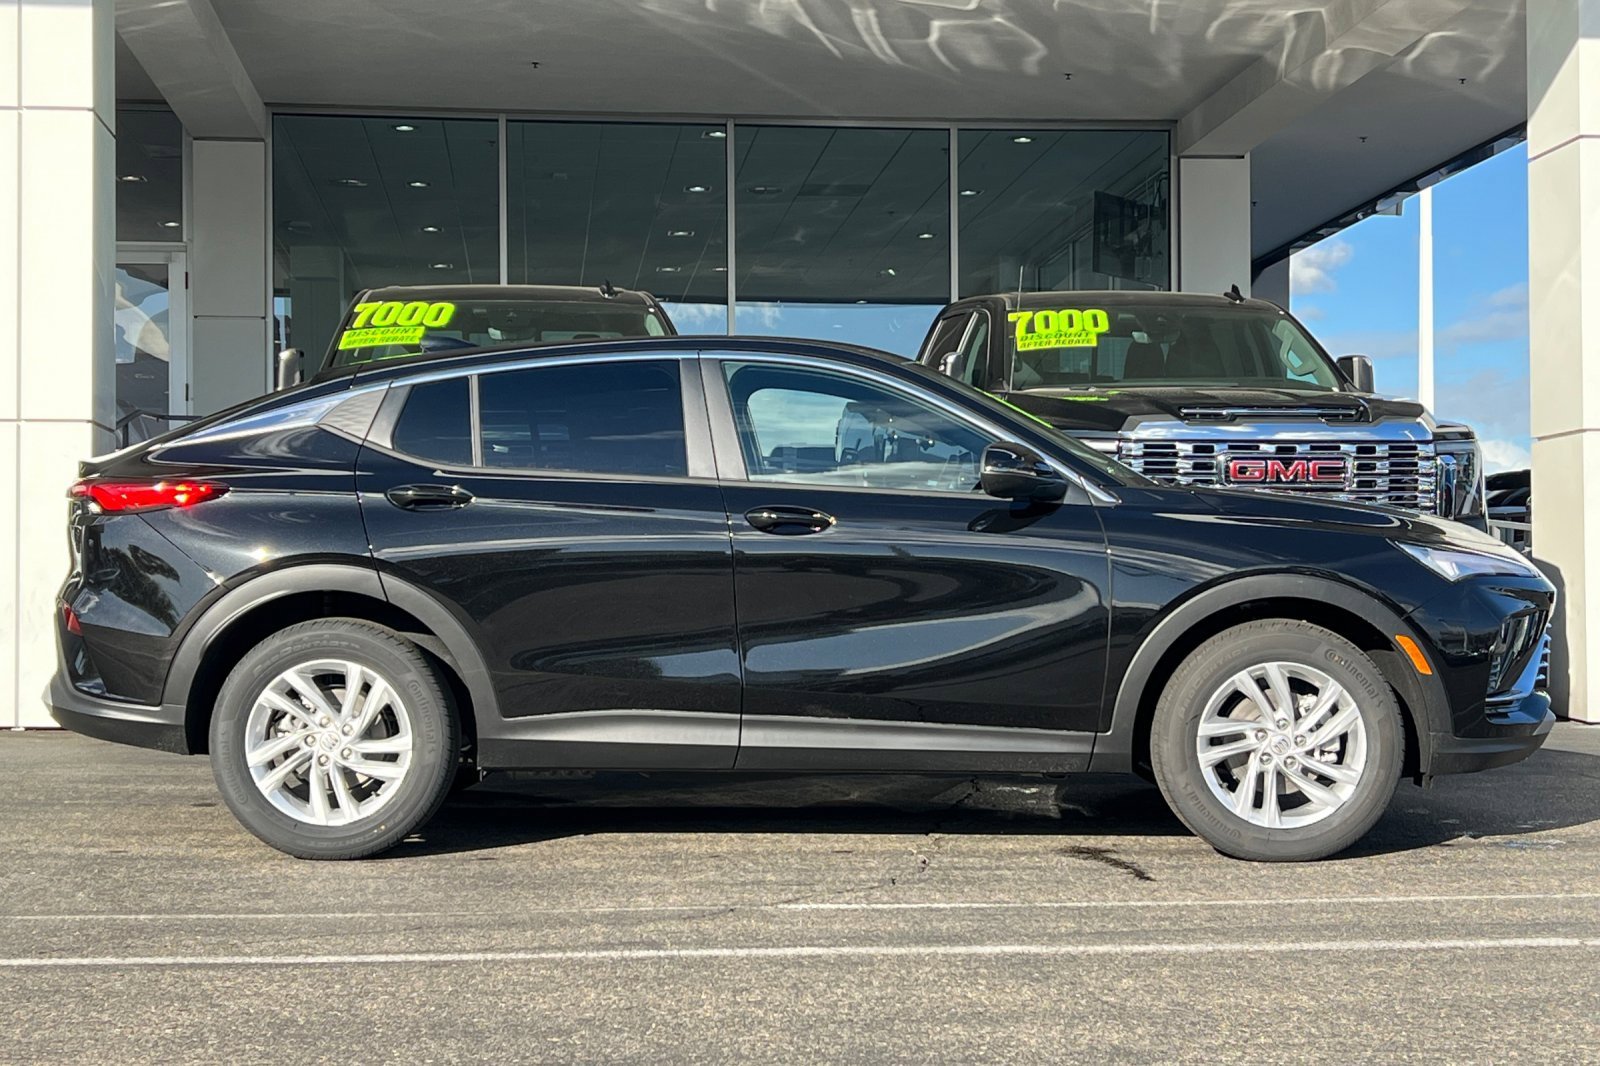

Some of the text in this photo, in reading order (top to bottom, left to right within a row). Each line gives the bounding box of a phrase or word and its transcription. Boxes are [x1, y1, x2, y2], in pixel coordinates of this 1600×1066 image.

[353, 301, 455, 329] 7000
[1008, 309, 1109, 337] 7000
[344, 335, 417, 346] AFTER REBATE
[348, 327, 418, 338] DISCOUNT
[1020, 331, 1090, 342] DISCOUNT
[1020, 338, 1093, 349] AFTER REBATE
[1229, 459, 1345, 482] GMC
[1324, 648, 1380, 700] Continental
[407, 679, 437, 743] Continental
